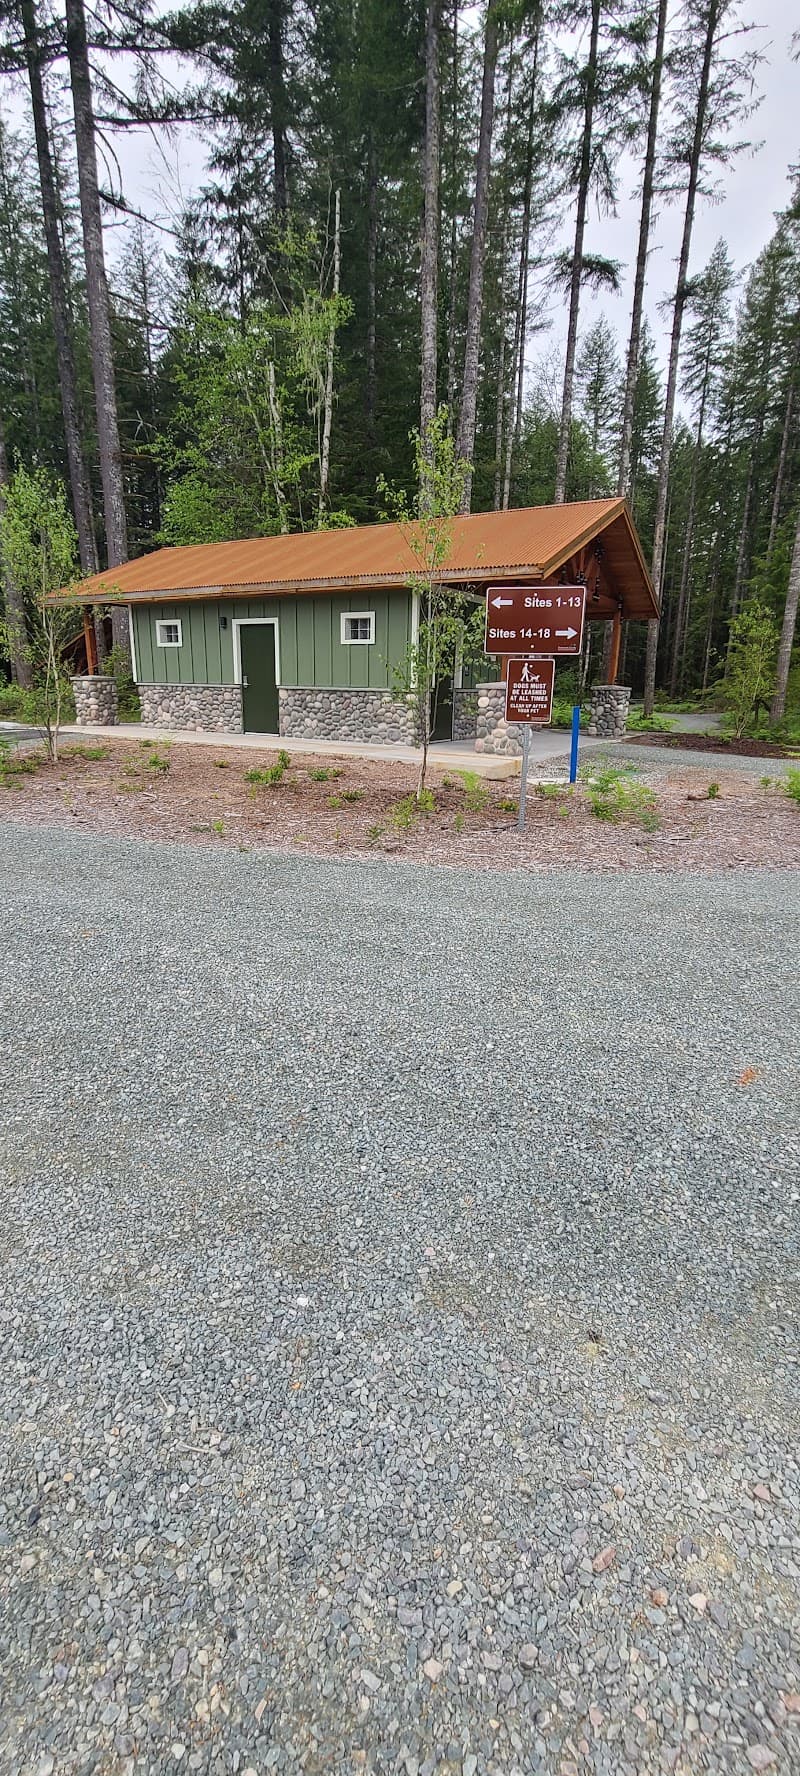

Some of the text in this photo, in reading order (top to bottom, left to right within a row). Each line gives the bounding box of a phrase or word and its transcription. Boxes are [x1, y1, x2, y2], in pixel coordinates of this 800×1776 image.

[524, 597, 581, 607] Sites 1-13
[489, 628, 551, 638] Sites 14-18
